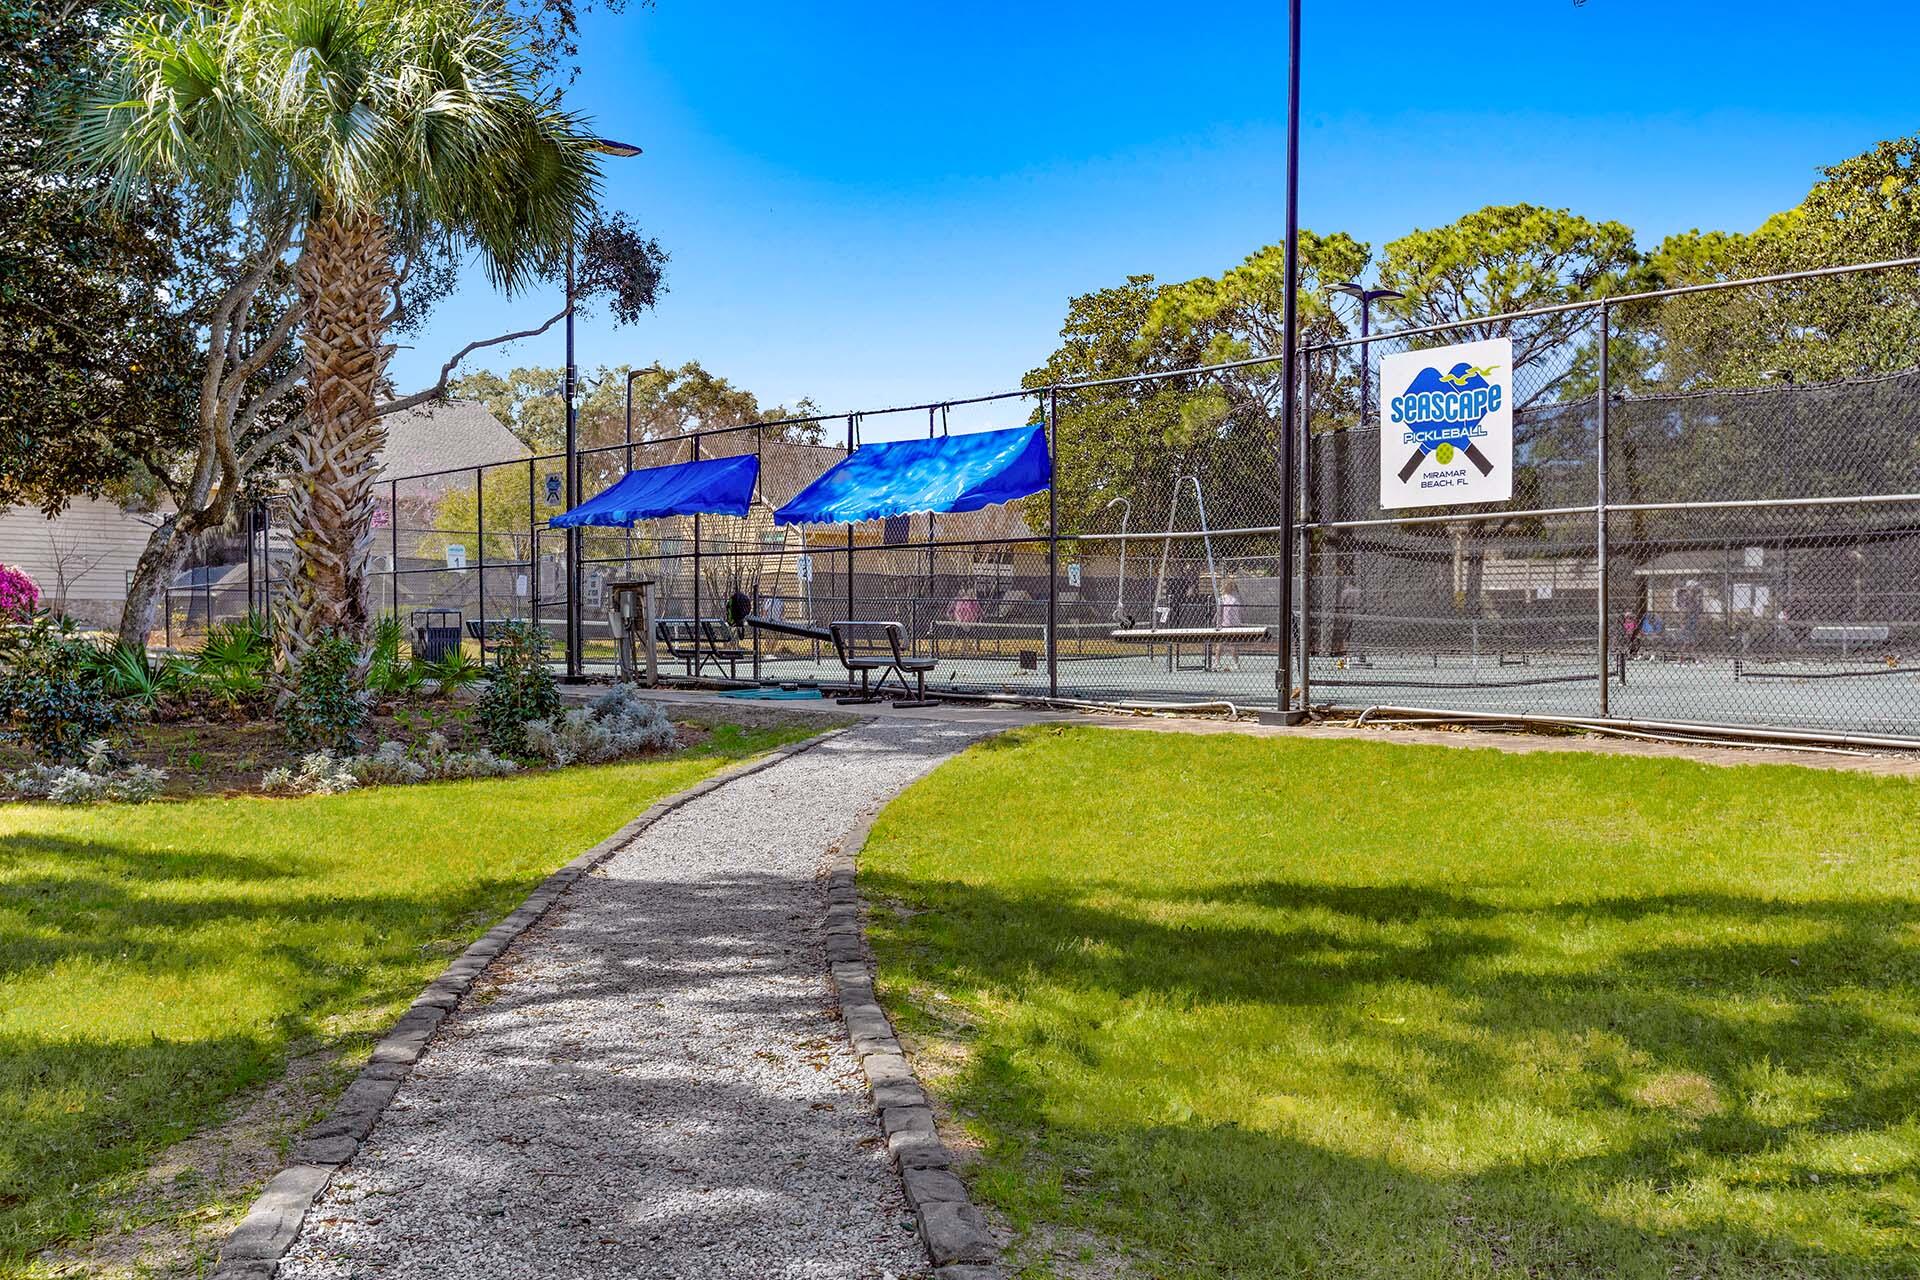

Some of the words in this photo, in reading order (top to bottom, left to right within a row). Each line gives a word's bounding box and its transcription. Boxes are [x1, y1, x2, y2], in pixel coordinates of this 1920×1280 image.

[1403, 425, 1488, 444] PICKLEBALL
[1423, 470, 1466, 479] MIRAMAR
[1420, 480, 1455, 489] BEACH,
